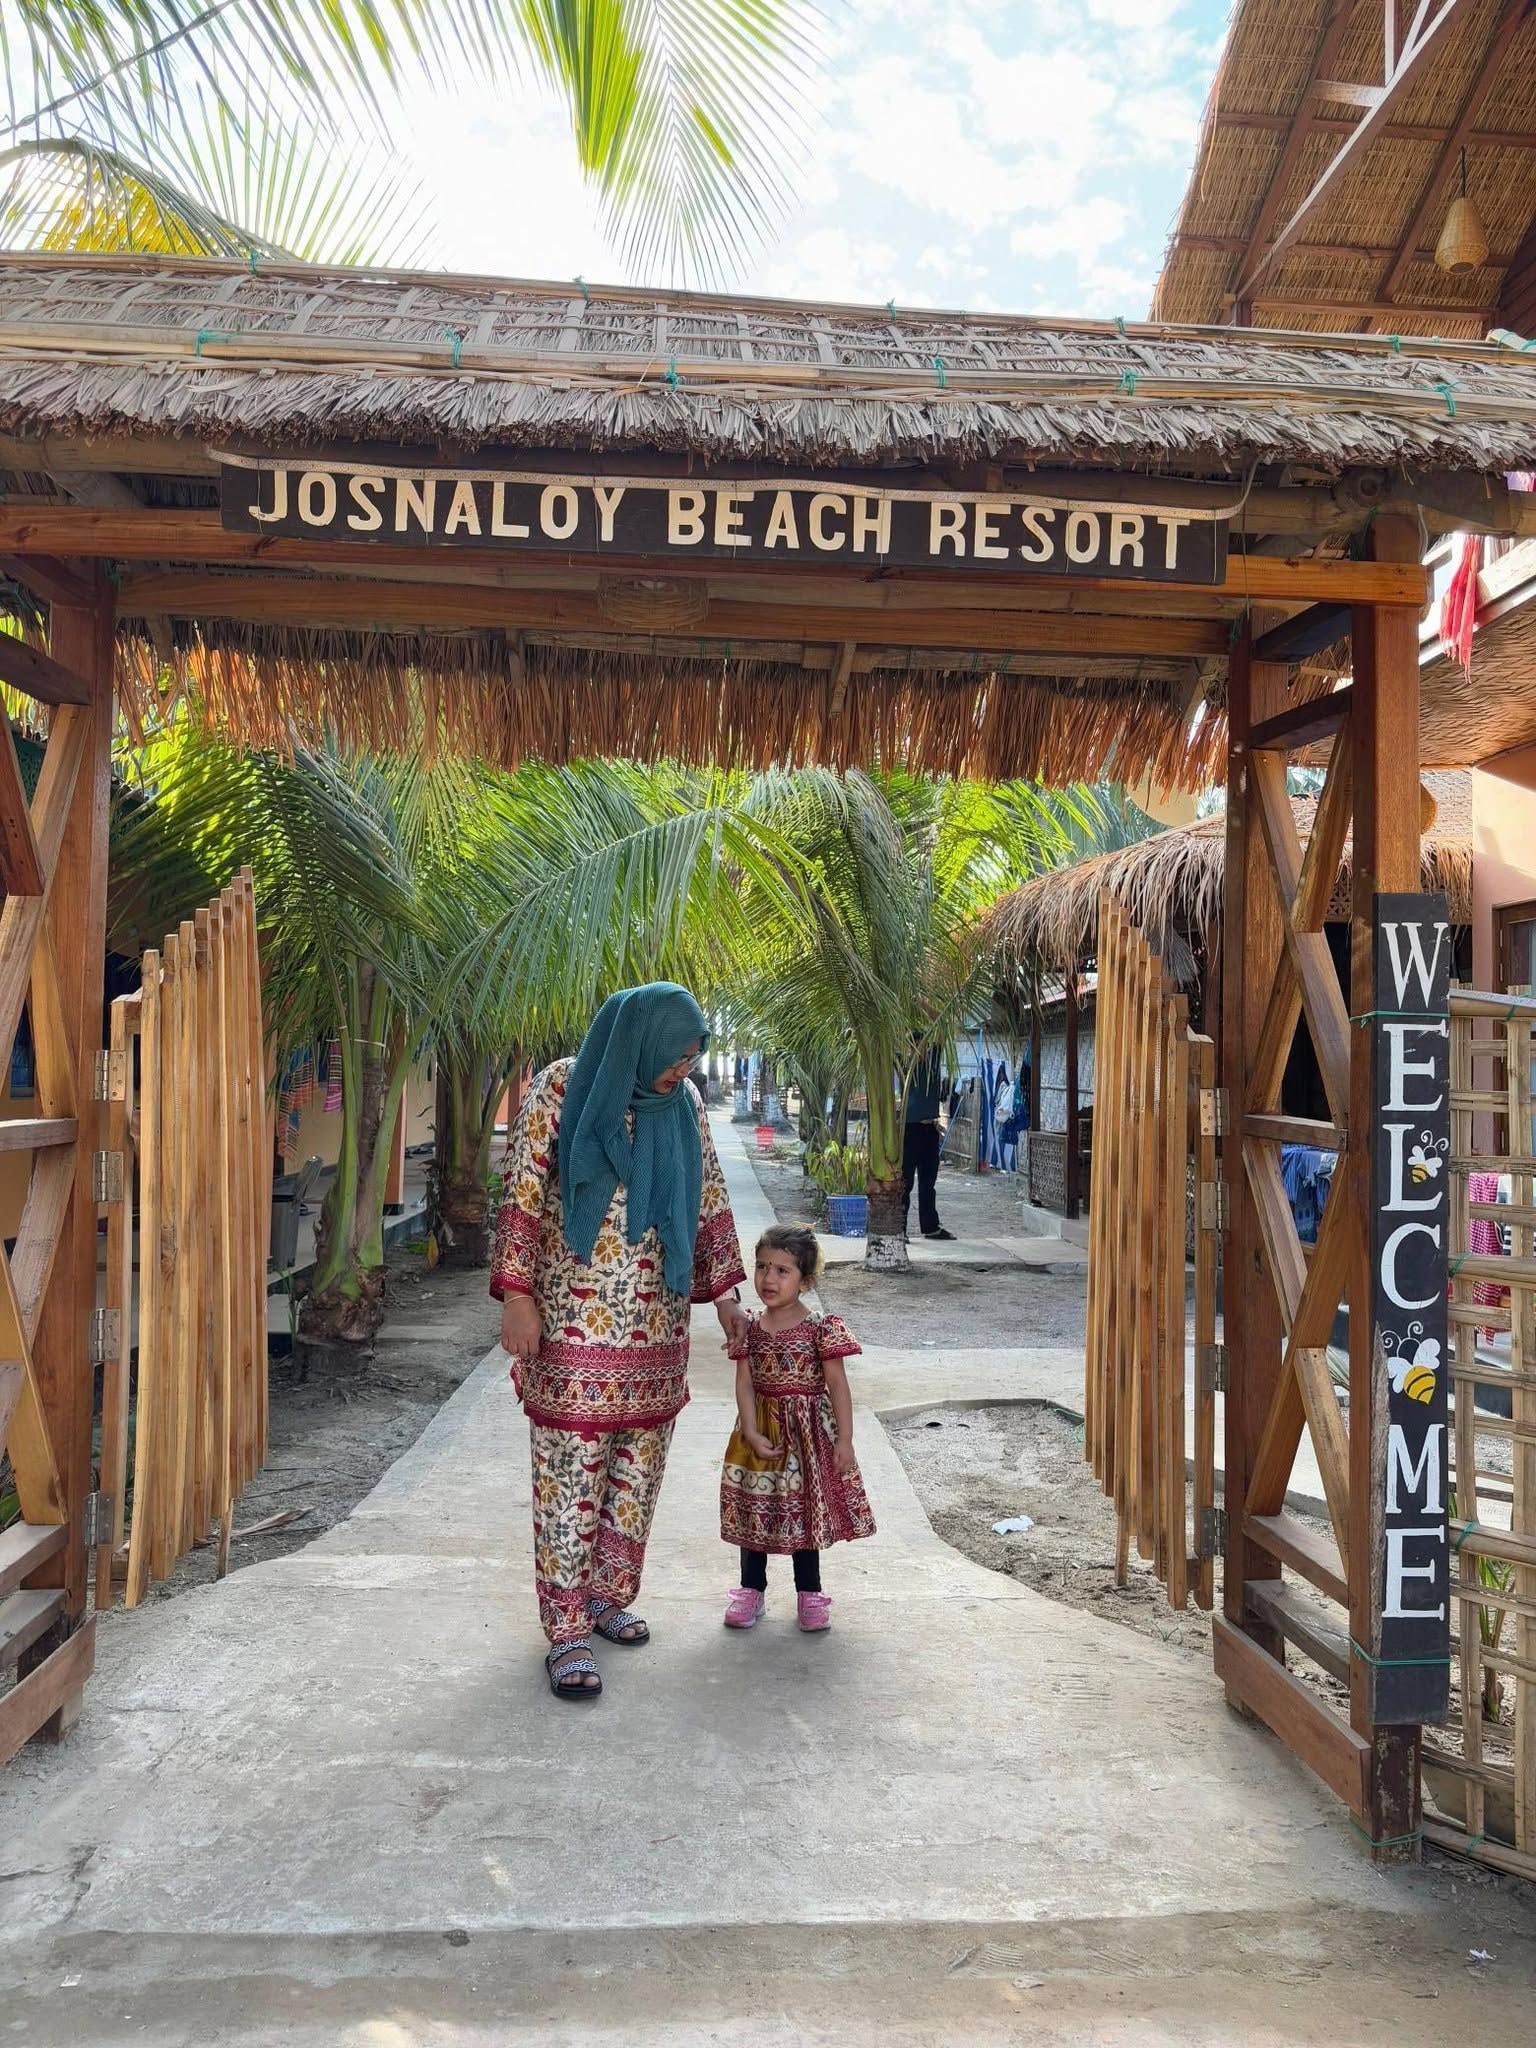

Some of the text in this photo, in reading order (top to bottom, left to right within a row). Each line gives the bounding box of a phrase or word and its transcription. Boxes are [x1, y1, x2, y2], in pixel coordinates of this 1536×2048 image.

[248, 469, 1191, 570] JOSNALOY BEACH RESORT
